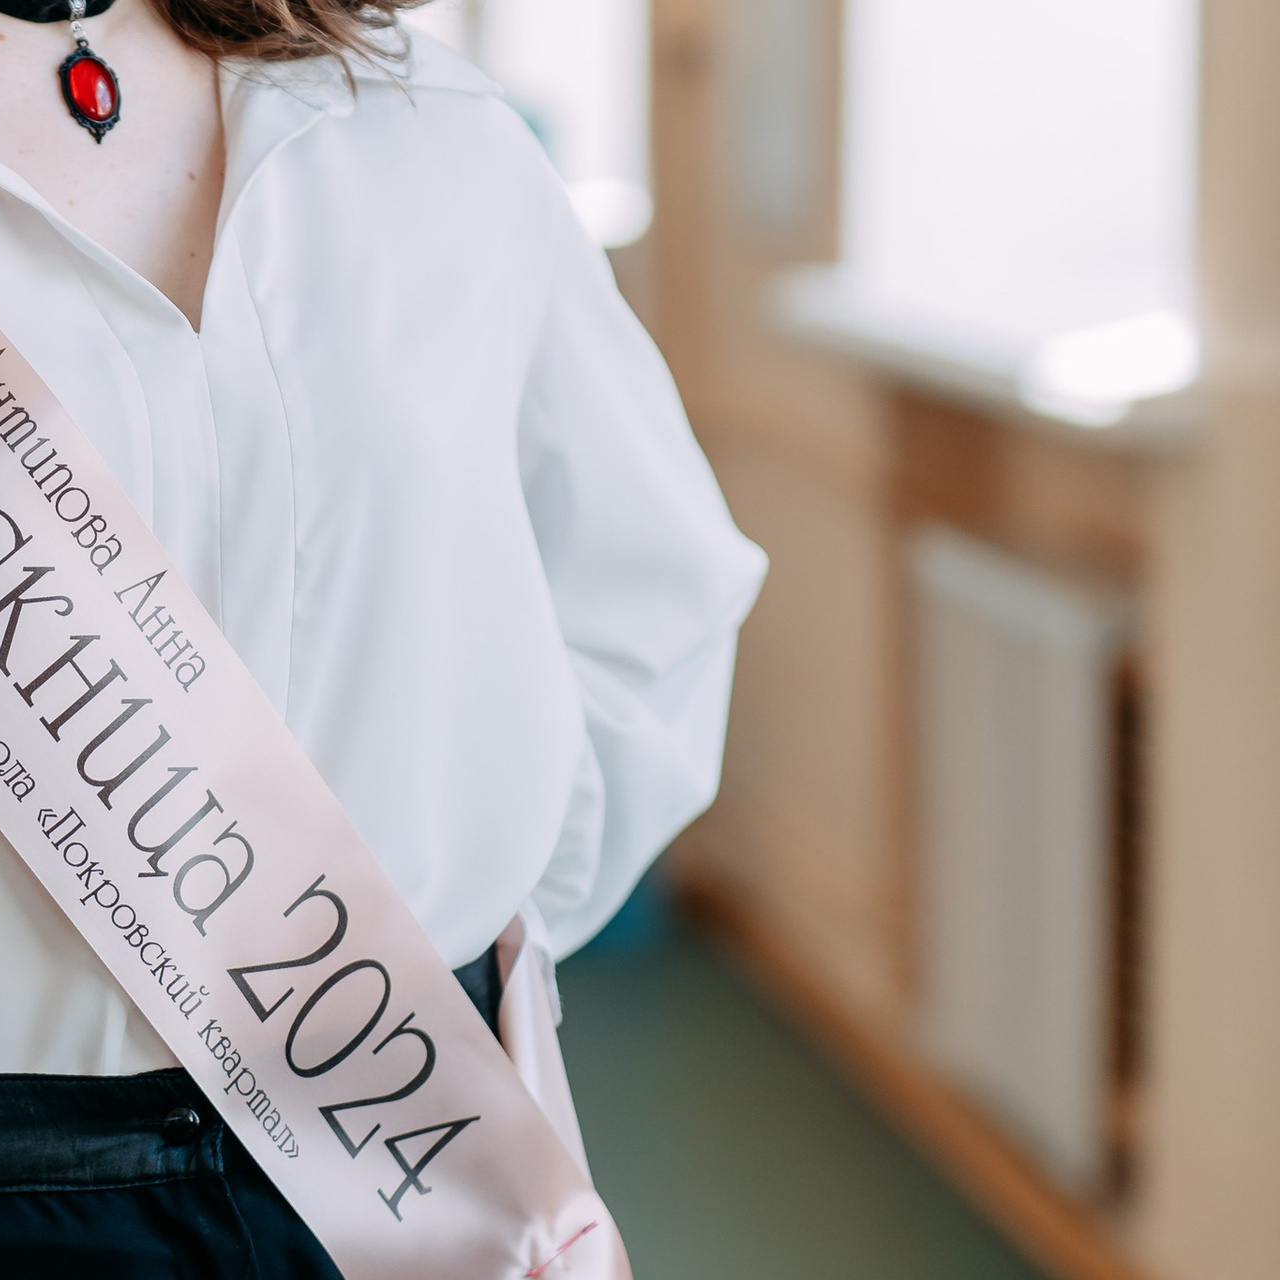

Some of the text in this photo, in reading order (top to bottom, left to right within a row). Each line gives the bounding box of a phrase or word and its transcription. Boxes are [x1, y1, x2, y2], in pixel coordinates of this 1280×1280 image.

[113, 569, 206, 694] Анна
[36, 805, 210, 1021] «Покровский
[196, 1018, 299, 1159] квартал»
[225, 873, 481, 1223] 2024
